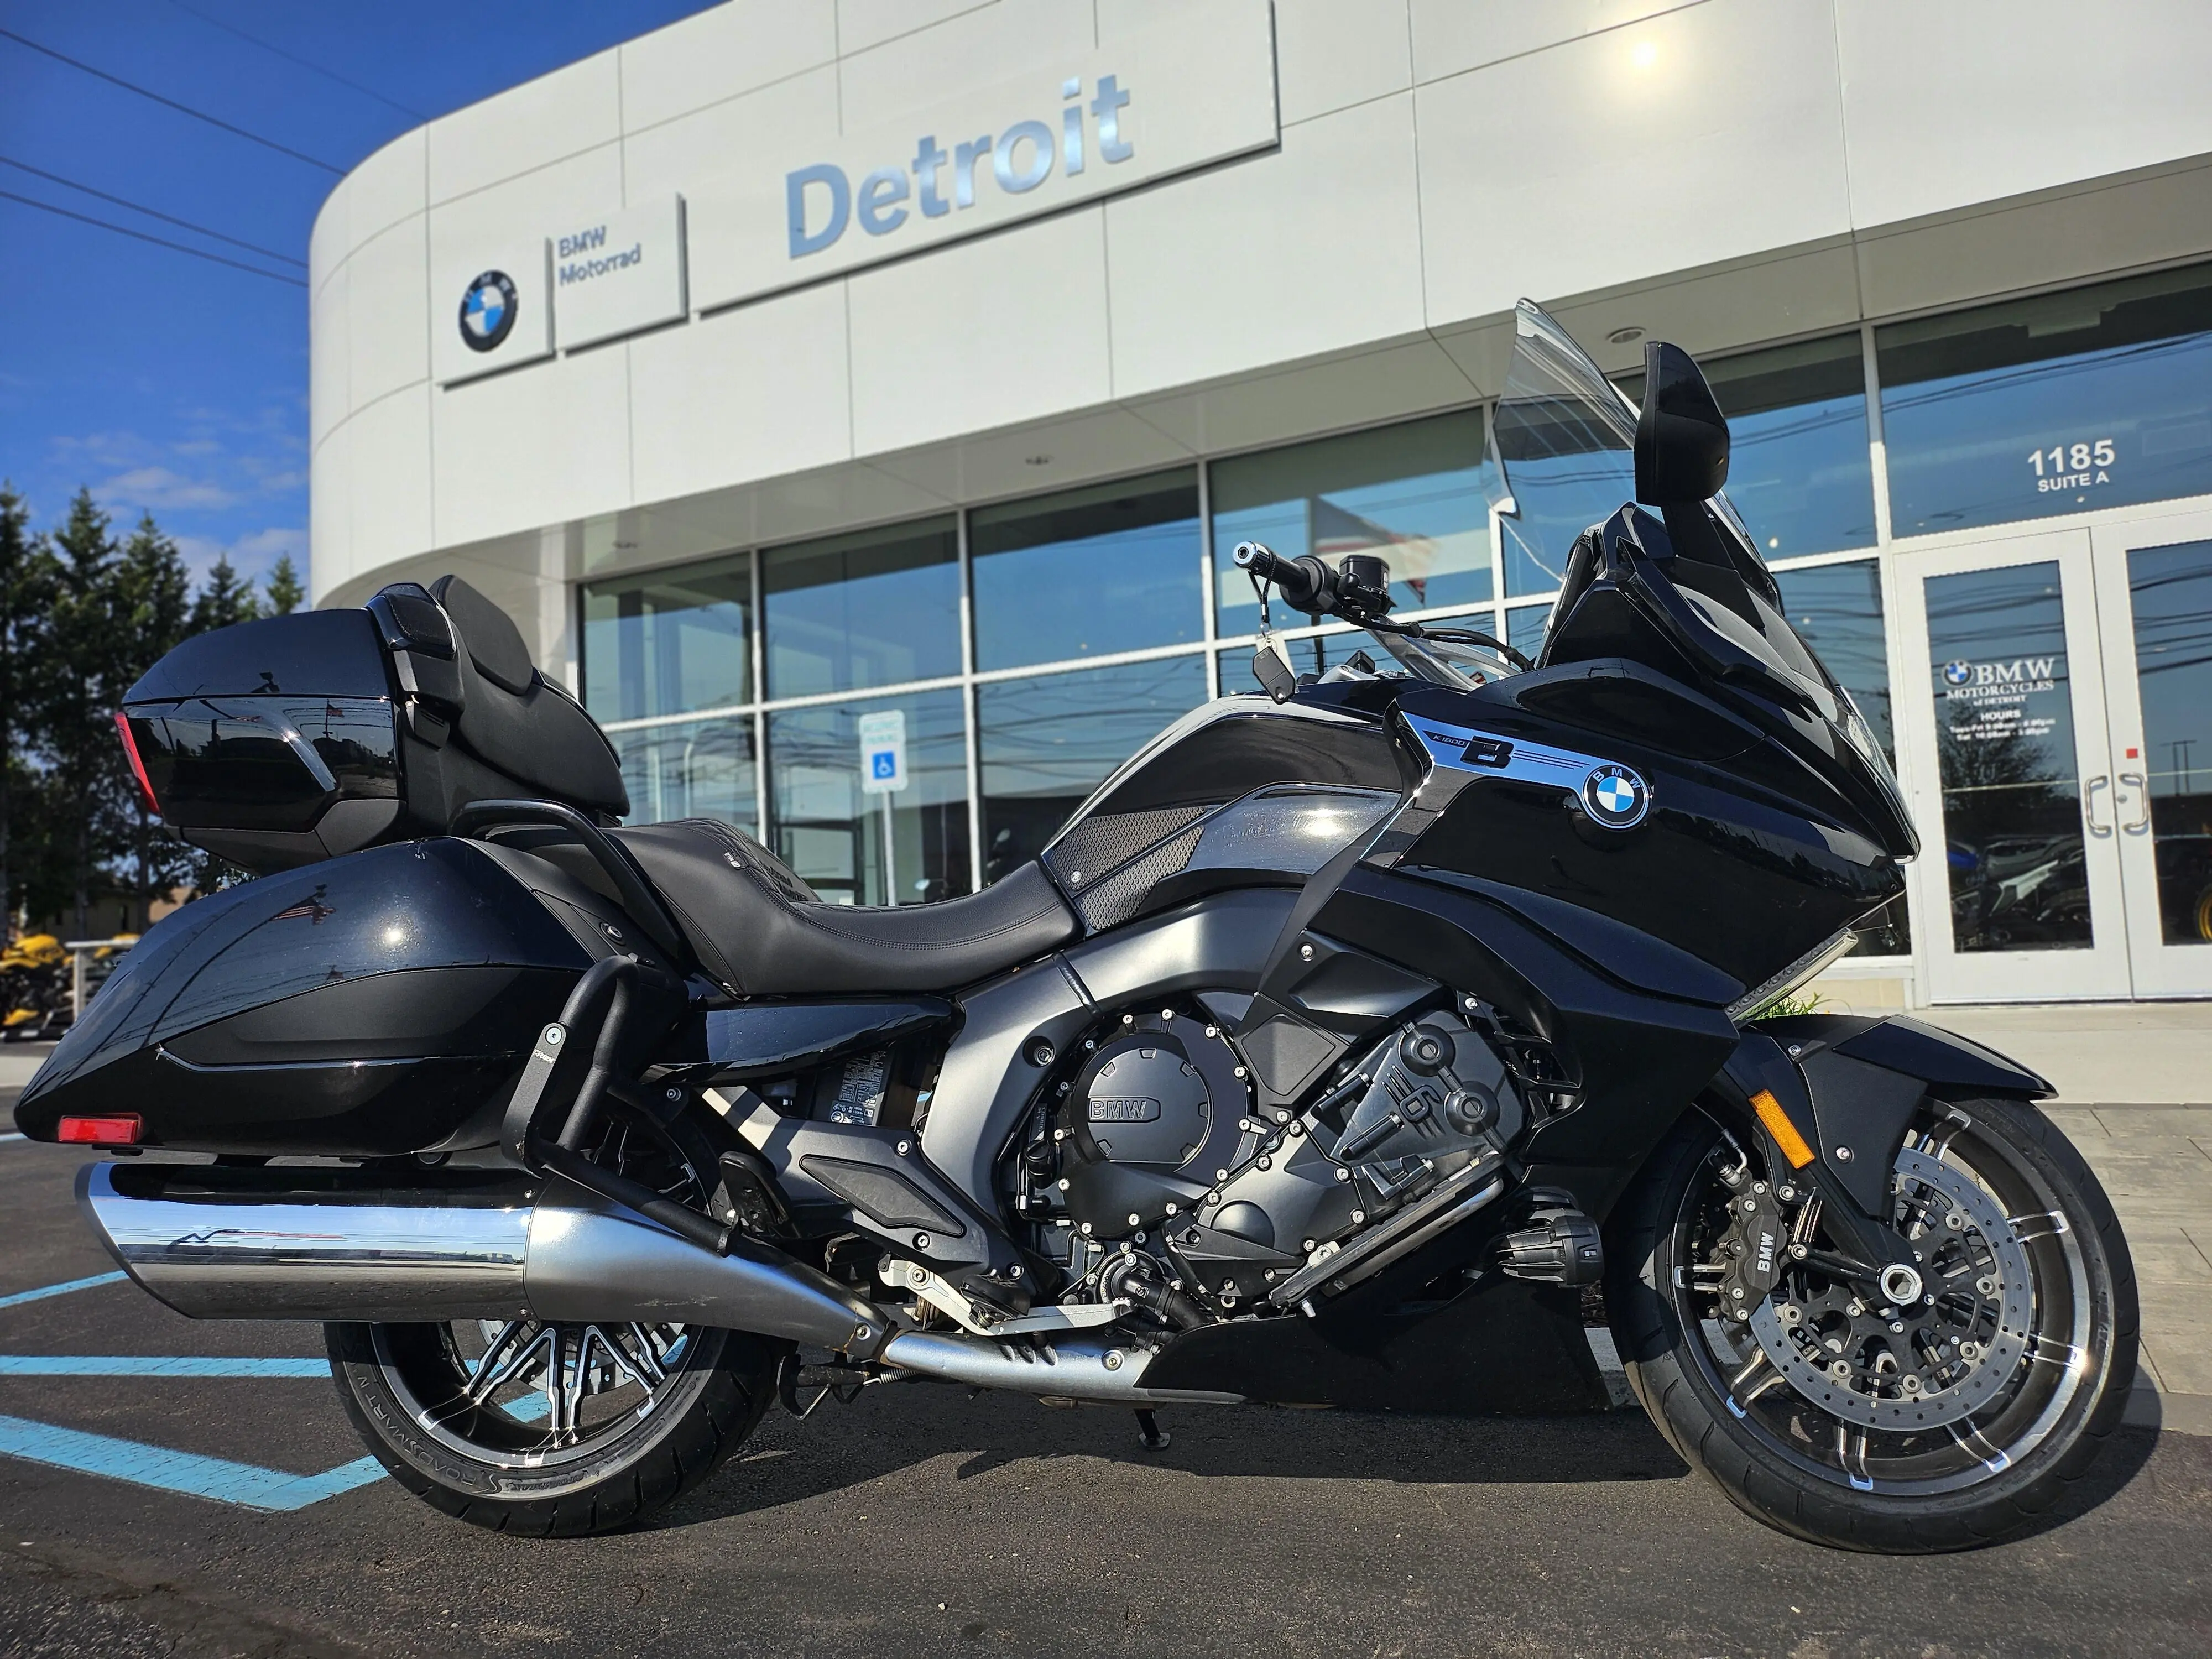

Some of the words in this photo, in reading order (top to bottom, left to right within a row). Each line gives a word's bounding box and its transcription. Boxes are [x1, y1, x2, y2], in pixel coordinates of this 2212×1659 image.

[786, 74, 1134, 260] Detroit
[559, 225, 607, 259] BMW
[559, 242, 641, 286] Motorrad
[2027, 439, 2115, 476] 1185
[2038, 473, 2091, 492] SUITE
[2095, 471, 2110, 484] A
[1975, 657, 2055, 685] BMW
[1946, 680, 2055, 700] MOTORCYCLES
[1980, 709, 2022, 721] HOURS
[1592, 768, 1641, 790] BMW
[1091, 1100, 1146, 1119] BMW
[1757, 1232, 1774, 1272] BMW
